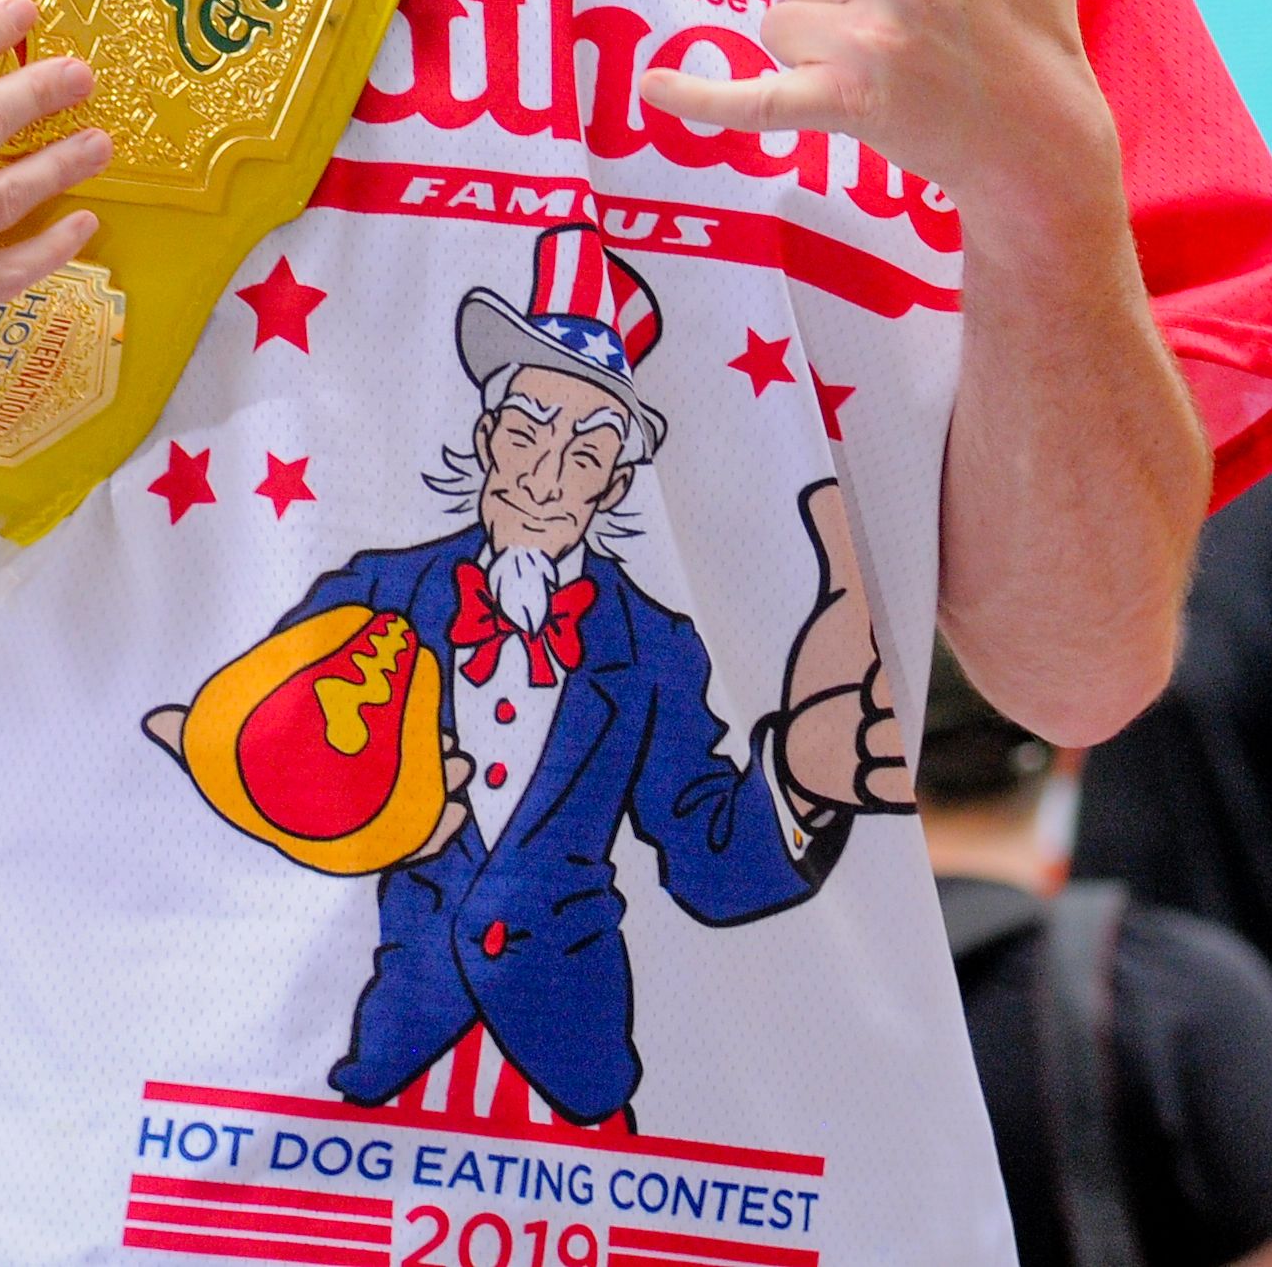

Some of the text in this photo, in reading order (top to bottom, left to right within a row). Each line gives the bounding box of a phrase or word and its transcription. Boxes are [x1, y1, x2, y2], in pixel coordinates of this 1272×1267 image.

[138, 1117, 819, 1232] HOT DOG EATING CONTEST
[401, 1205, 597, 1267] 2019
